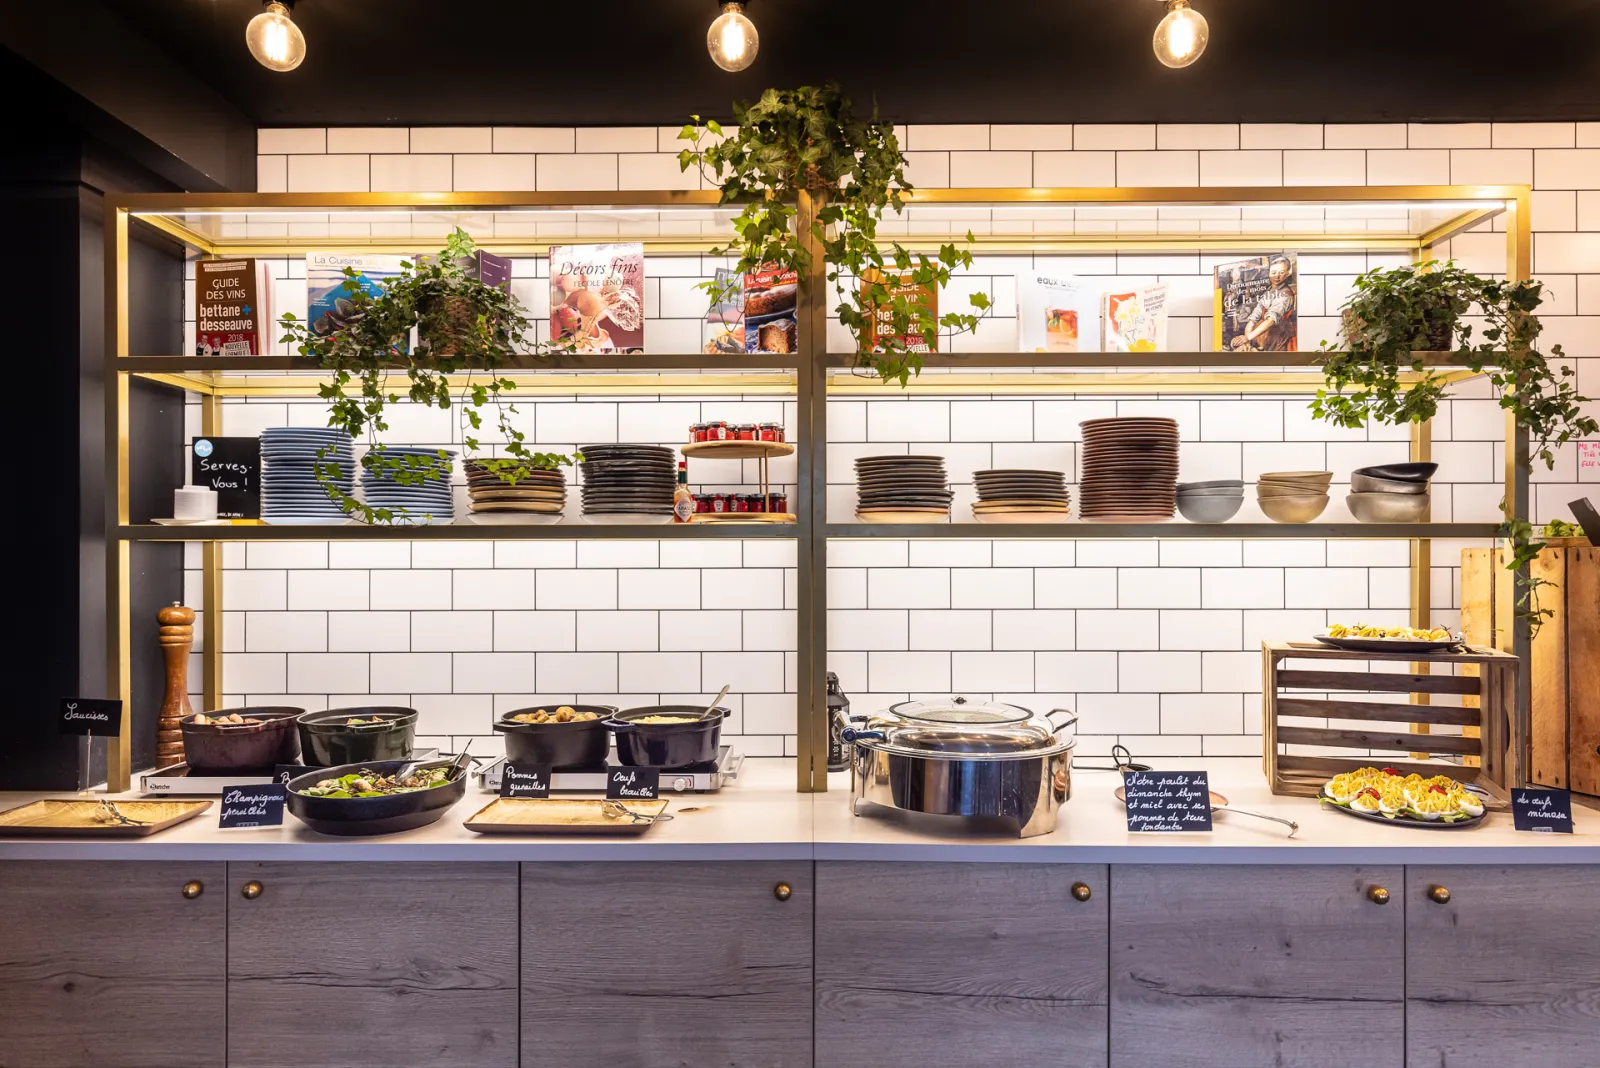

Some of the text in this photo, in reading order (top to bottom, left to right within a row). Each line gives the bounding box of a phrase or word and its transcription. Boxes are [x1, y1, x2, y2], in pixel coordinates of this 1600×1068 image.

[314, 256, 326, 264] La
[328, 256, 363, 265] Cuisine
[559, 258, 638, 279] Décors fins
[212, 278, 239, 289] GUIDE
[206, 289, 246, 300] DES VINS
[904, 293, 921, 303] VIN
[1224, 290, 1286, 308] de la table
[200, 304, 240, 317] bettane
[876, 308, 919, 321] bete
[200, 318, 252, 331] desseauve
[228, 334, 244, 342] 2018
[906, 337, 924, 345] 2018
[224, 342, 248, 350] NOUVELLE
[212, 476, 238, 489] Vous
[505, 765, 538, 779] Pommes
[1126, 772, 1206, 790] Notre poulet du
[619, 784, 653, 797] brouillés
[1127, 787, 1202, 801] dimanche thym
[1128, 798, 1138, 809] et
[1140, 798, 1163, 809] miel
[1127, 811, 1206, 826] pommes de terre
[1527, 809, 1567, 819] mimosa
[1140, 821, 1183, 831] fondantes
